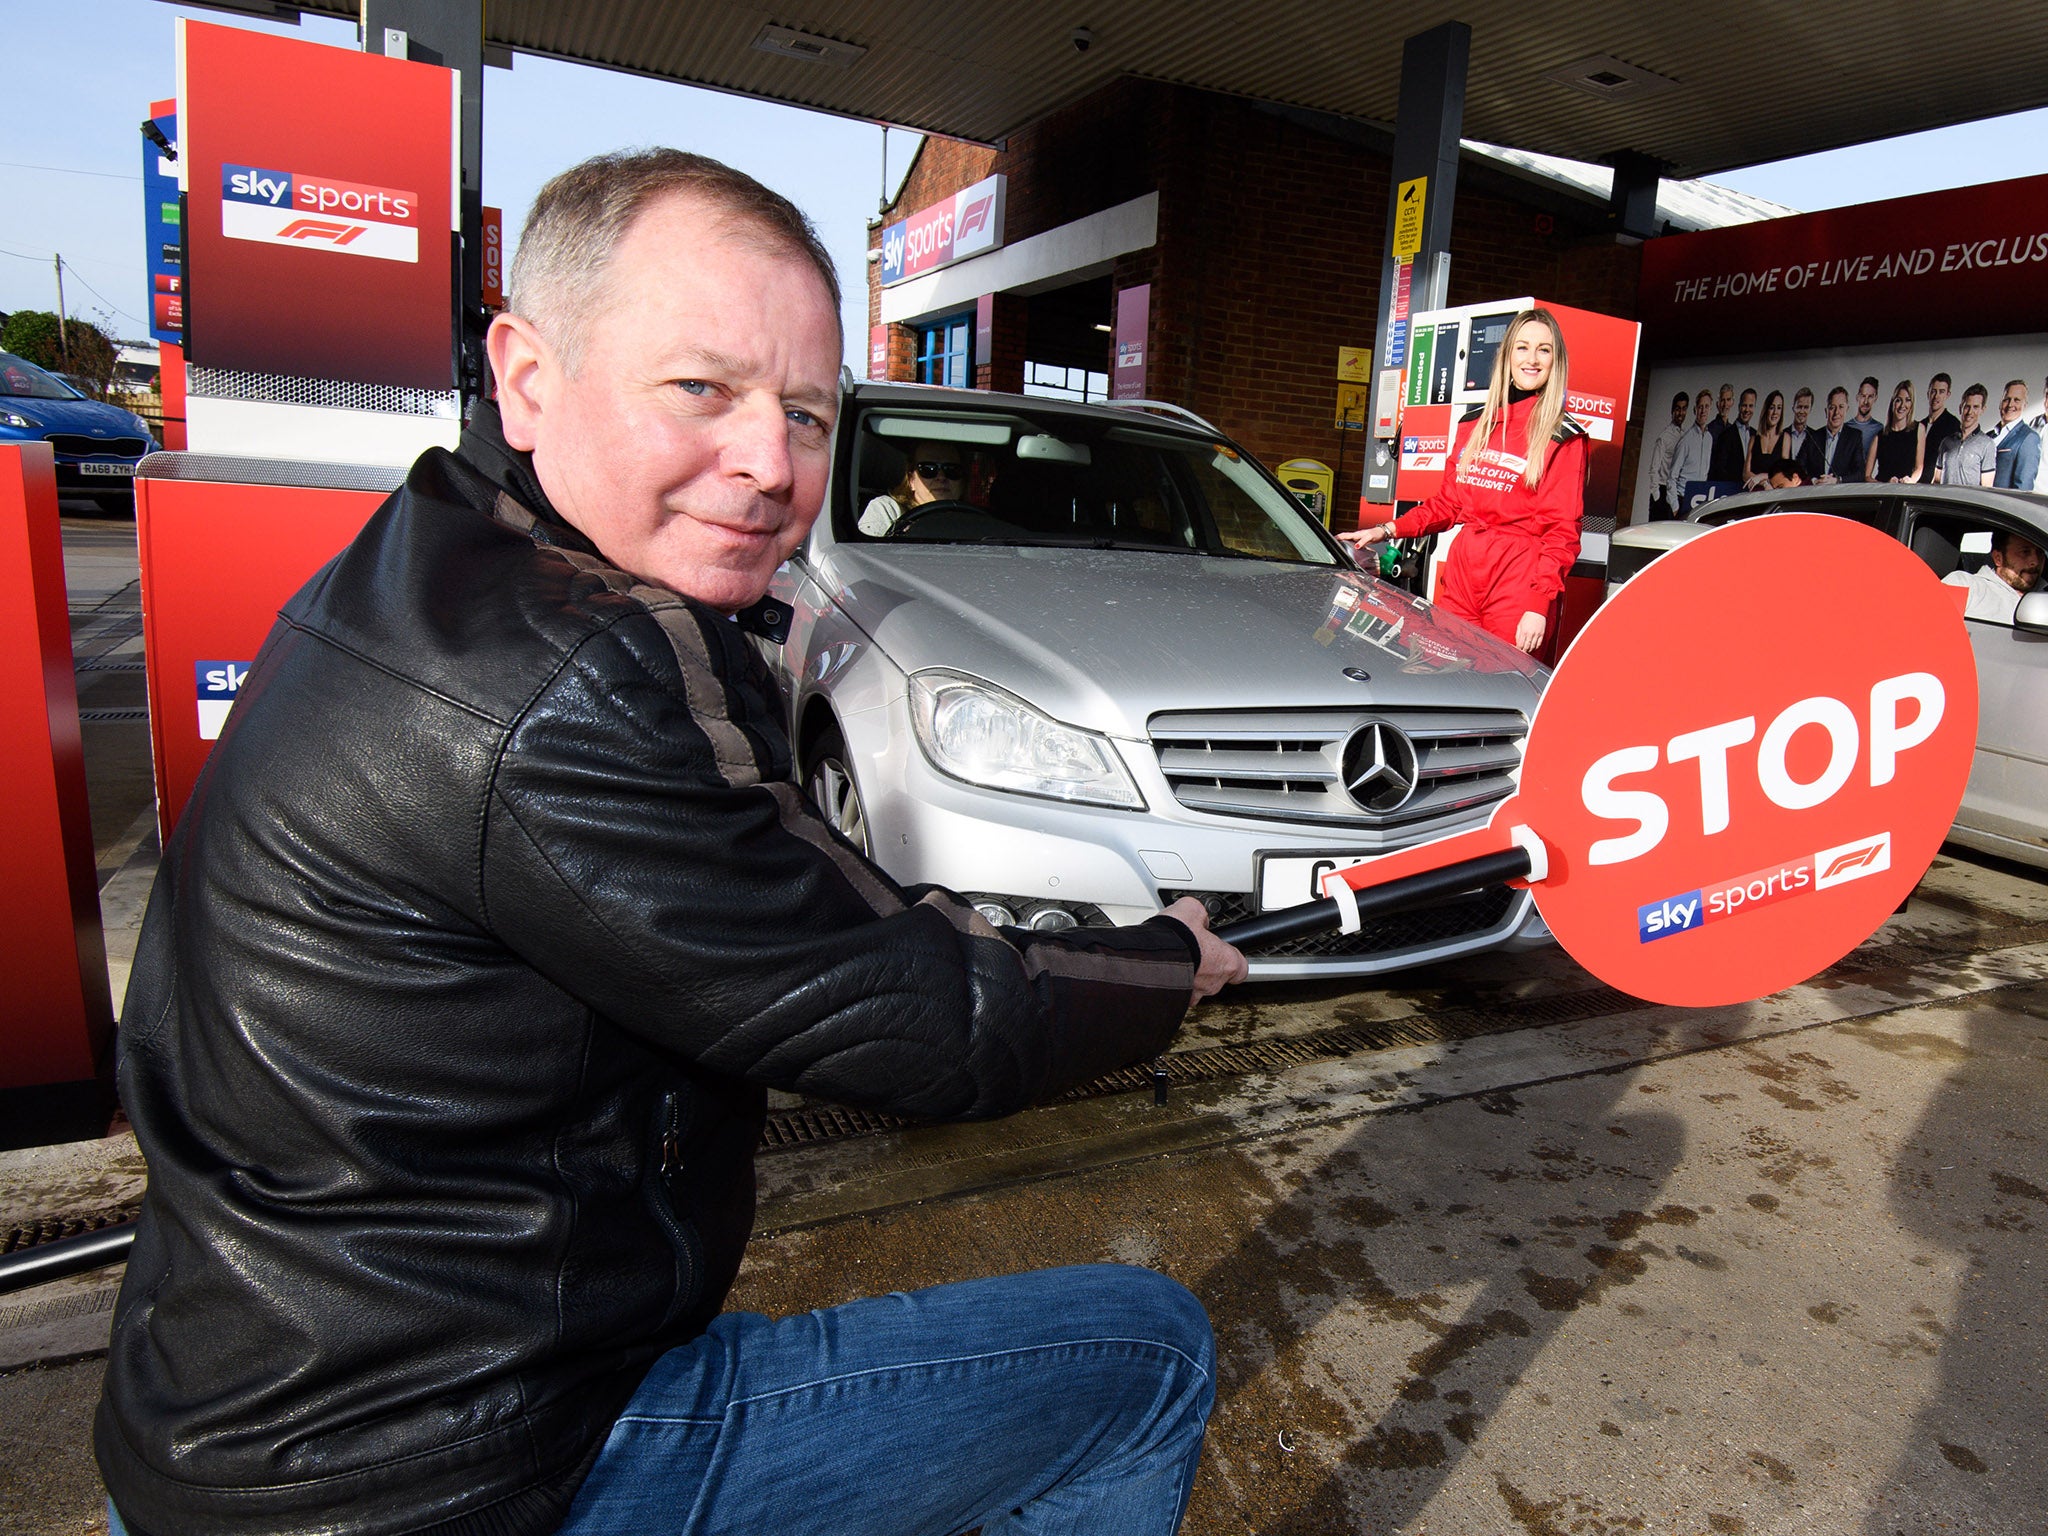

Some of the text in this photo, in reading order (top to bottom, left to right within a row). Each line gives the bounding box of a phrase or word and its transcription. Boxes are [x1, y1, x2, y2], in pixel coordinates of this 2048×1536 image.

[231, 171, 410, 218] sky sports
[1404, 206, 1416, 216] CCTV
[487, 224, 499, 288] SOS
[884, 230, 904, 275] sky
[907, 211, 953, 268] sports
[1675, 233, 2048, 303] THE HOME OF LIVE AND EXCLUS
[1415, 352, 1425, 403] Unleaded
[1438, 367, 1447, 402] Diesel
[1568, 396, 1612, 415] sports
[1405, 438, 1445, 452] sky sports
[84, 464, 131, 474] RA68 ZYH
[1488, 468, 1500, 478] OF
[1499, 470, 1519, 483] LIVE
[206, 664, 249, 691] sk
[1581, 672, 1945, 866] STOP
[1645, 898, 1698, 933] sky
[1708, 865, 1809, 914] sports
